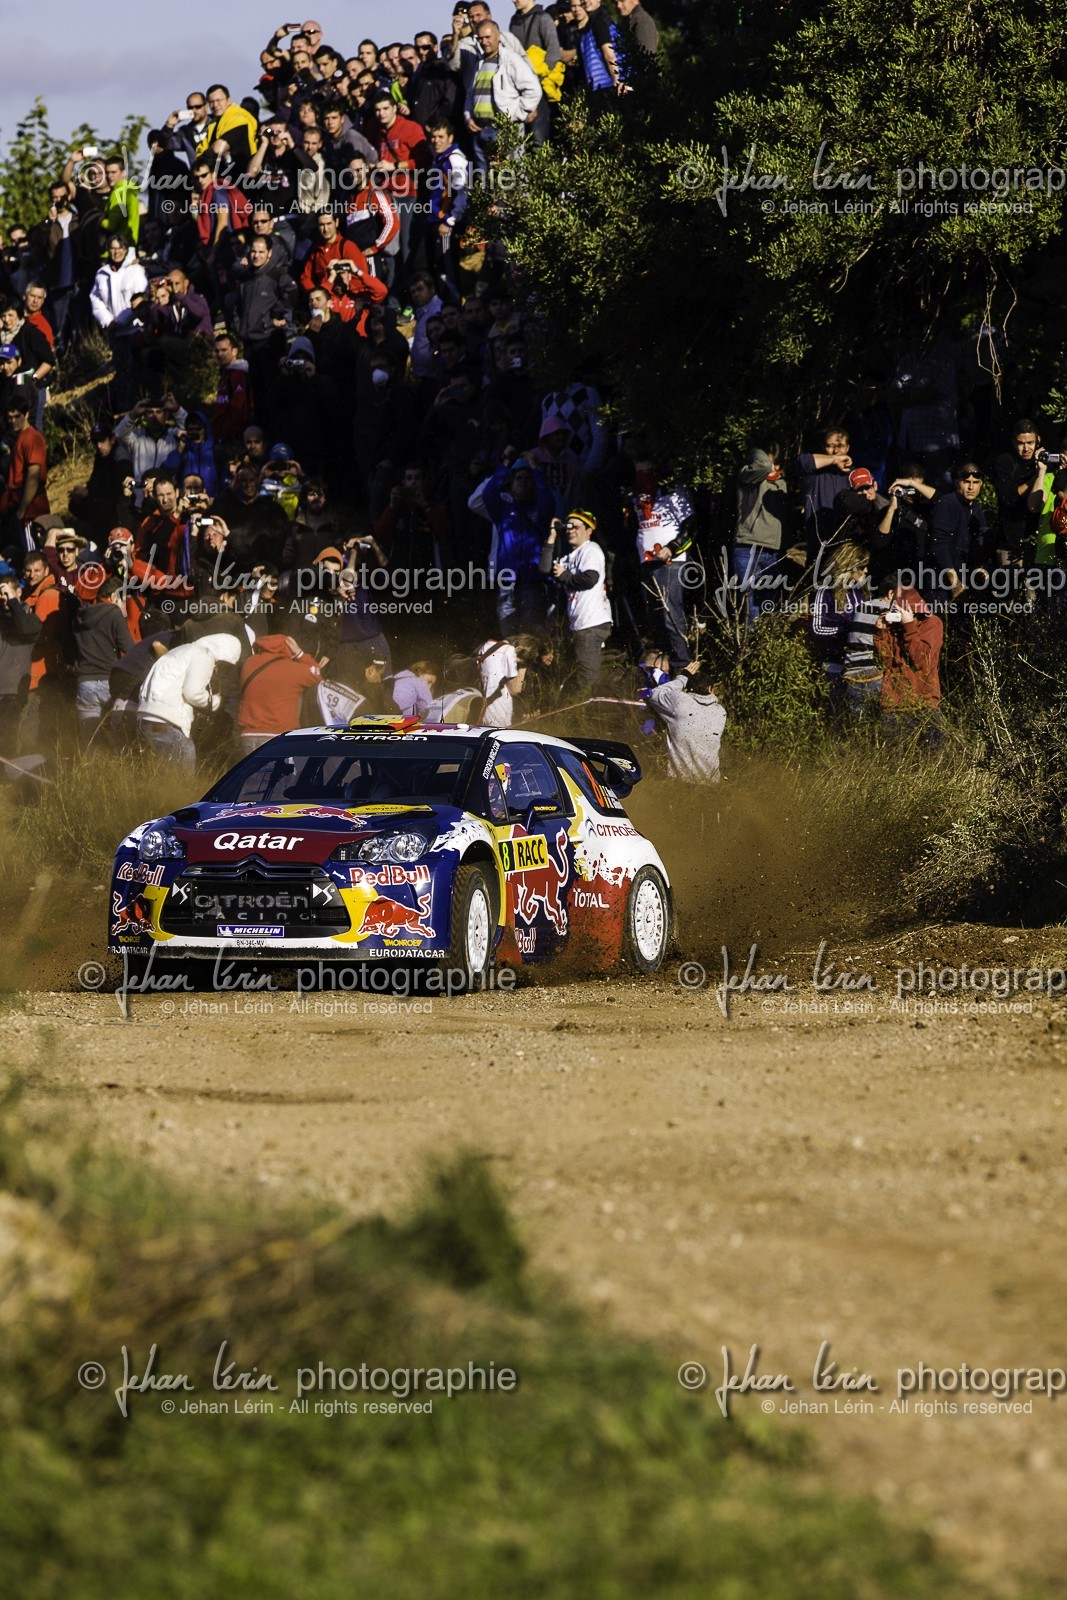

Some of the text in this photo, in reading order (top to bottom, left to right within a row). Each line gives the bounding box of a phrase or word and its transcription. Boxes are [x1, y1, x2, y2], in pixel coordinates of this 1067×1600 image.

[213, 832, 304, 851] Qatar
[502, 838, 545, 871] 8 RACC
[116, 861, 166, 887] Red Bull
[349, 864, 431, 888] Red Bull
[573, 887, 610, 909] TOTAL
[233, 927, 281, 935] MICHELIN
[382, 939, 423, 947] MONROE
[369, 949, 445, 958] EURODATACAR
